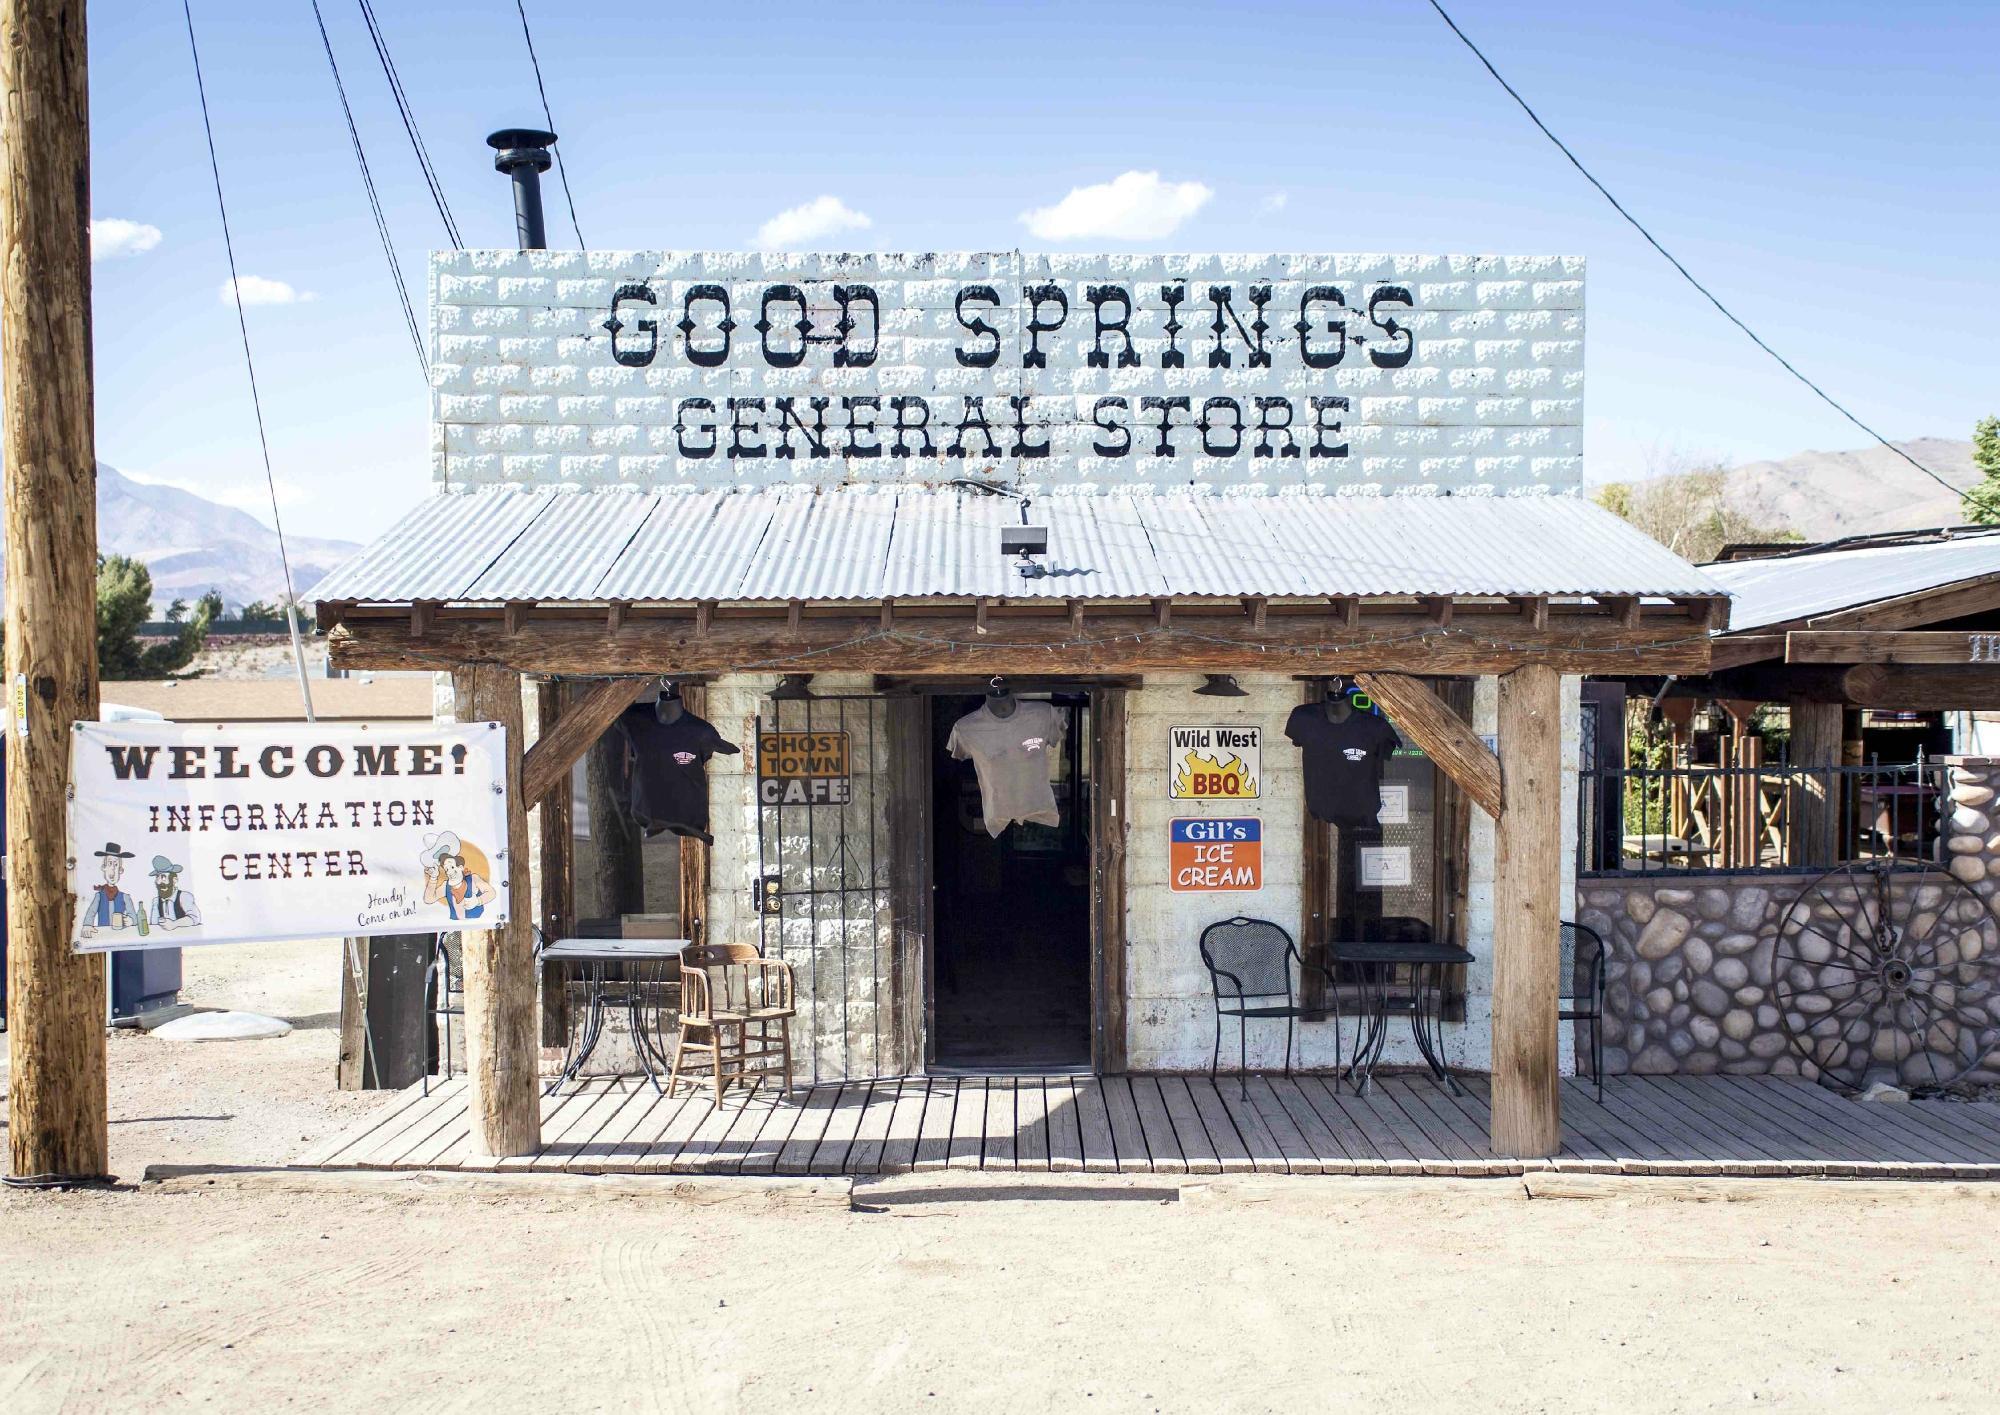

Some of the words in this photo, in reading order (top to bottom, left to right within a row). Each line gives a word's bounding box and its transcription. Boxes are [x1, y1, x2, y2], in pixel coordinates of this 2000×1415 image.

[602, 284, 880, 368] GOOD
[954, 284, 1414, 369] SPRINGS
[672, 396, 1050, 459] GENERAL
[1093, 396, 1350, 458] STORE
[761, 737, 847, 753] GHOST
[1174, 730, 1210, 748] Wild
[1216, 730, 1258, 748] West
[105, 743, 468, 781] WELCOME!
[767, 758, 841, 773] TOWN
[761, 779, 849, 803] CAFE
[1193, 773, 1240, 796] BBQ
[149, 800, 434, 832] INFORMATION
[1185, 822, 1247, 840] Gil's
[1194, 843, 1234, 863] ICE
[219, 850, 368, 881] CENTER
[1177, 866, 1255, 887] CREAM
[368, 886, 406, 909] Howdy!
[357, 912, 385, 927] Come
[389, 910, 400, 920] on
[403, 900, 416, 917] in!
